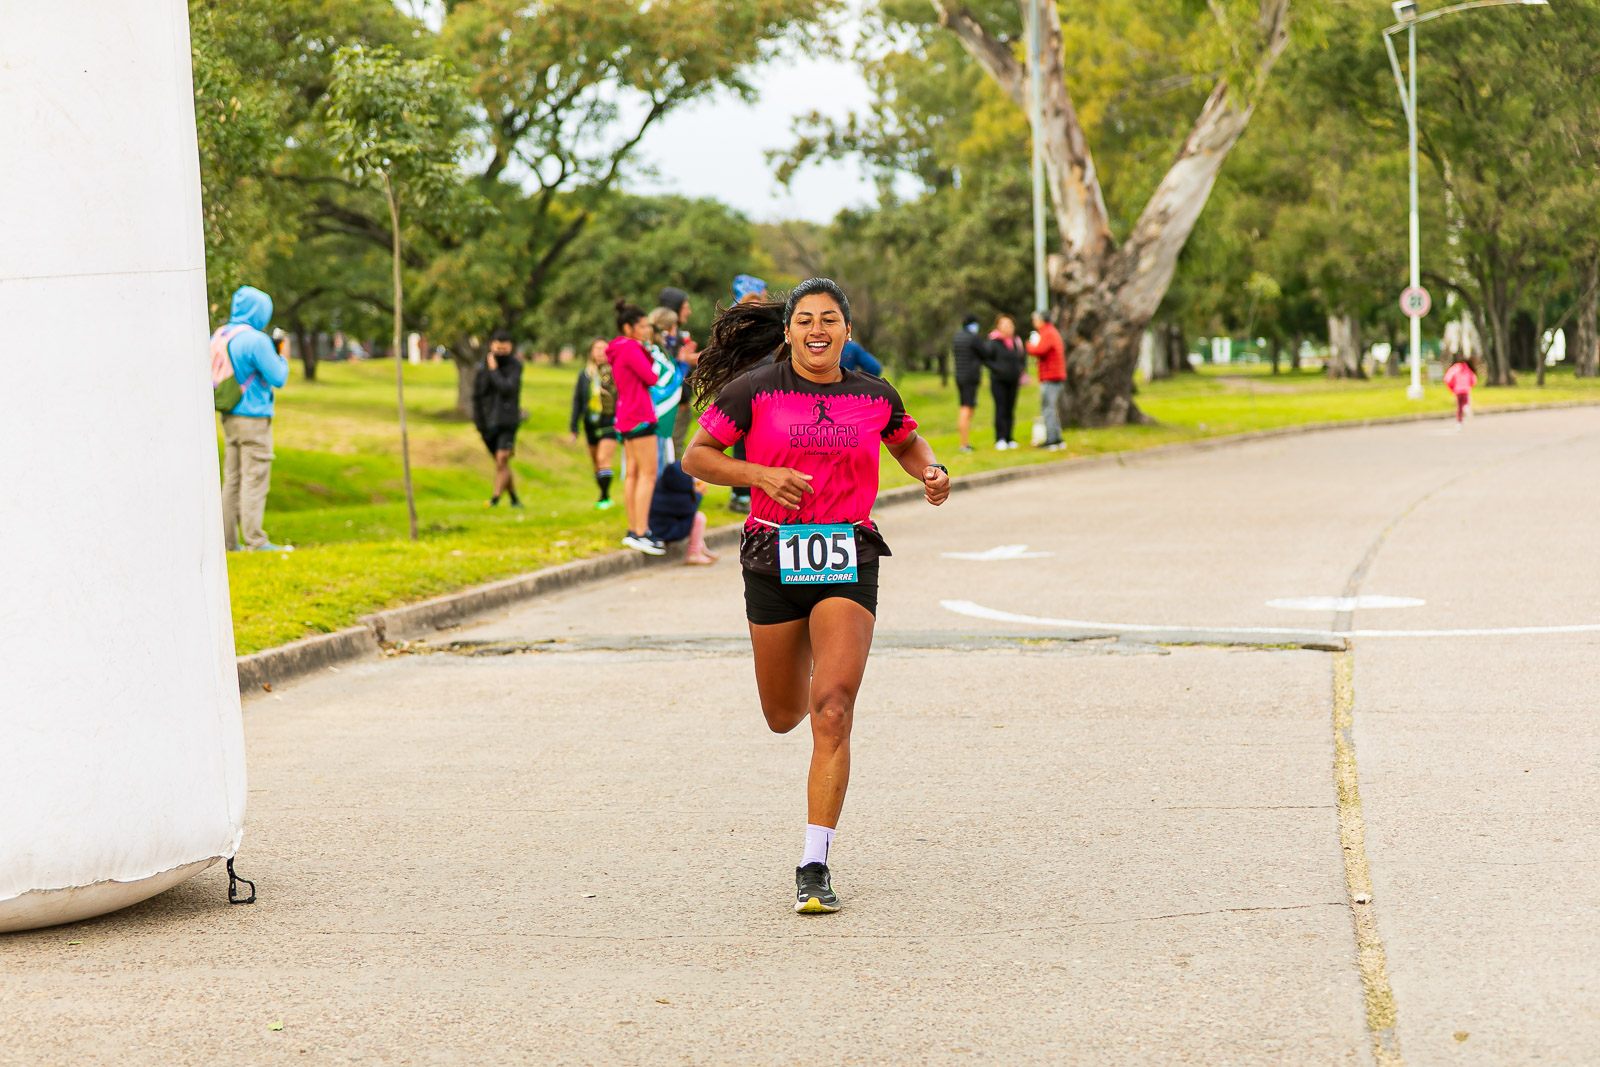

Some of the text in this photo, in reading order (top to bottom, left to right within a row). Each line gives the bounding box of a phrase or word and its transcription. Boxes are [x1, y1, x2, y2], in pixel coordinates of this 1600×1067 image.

[790, 425, 858, 436] WOMAN
[790, 437, 859, 448] RUNNING
[785, 533, 849, 571] 105
[785, 573, 853, 582] DIAMANTE CORRE
